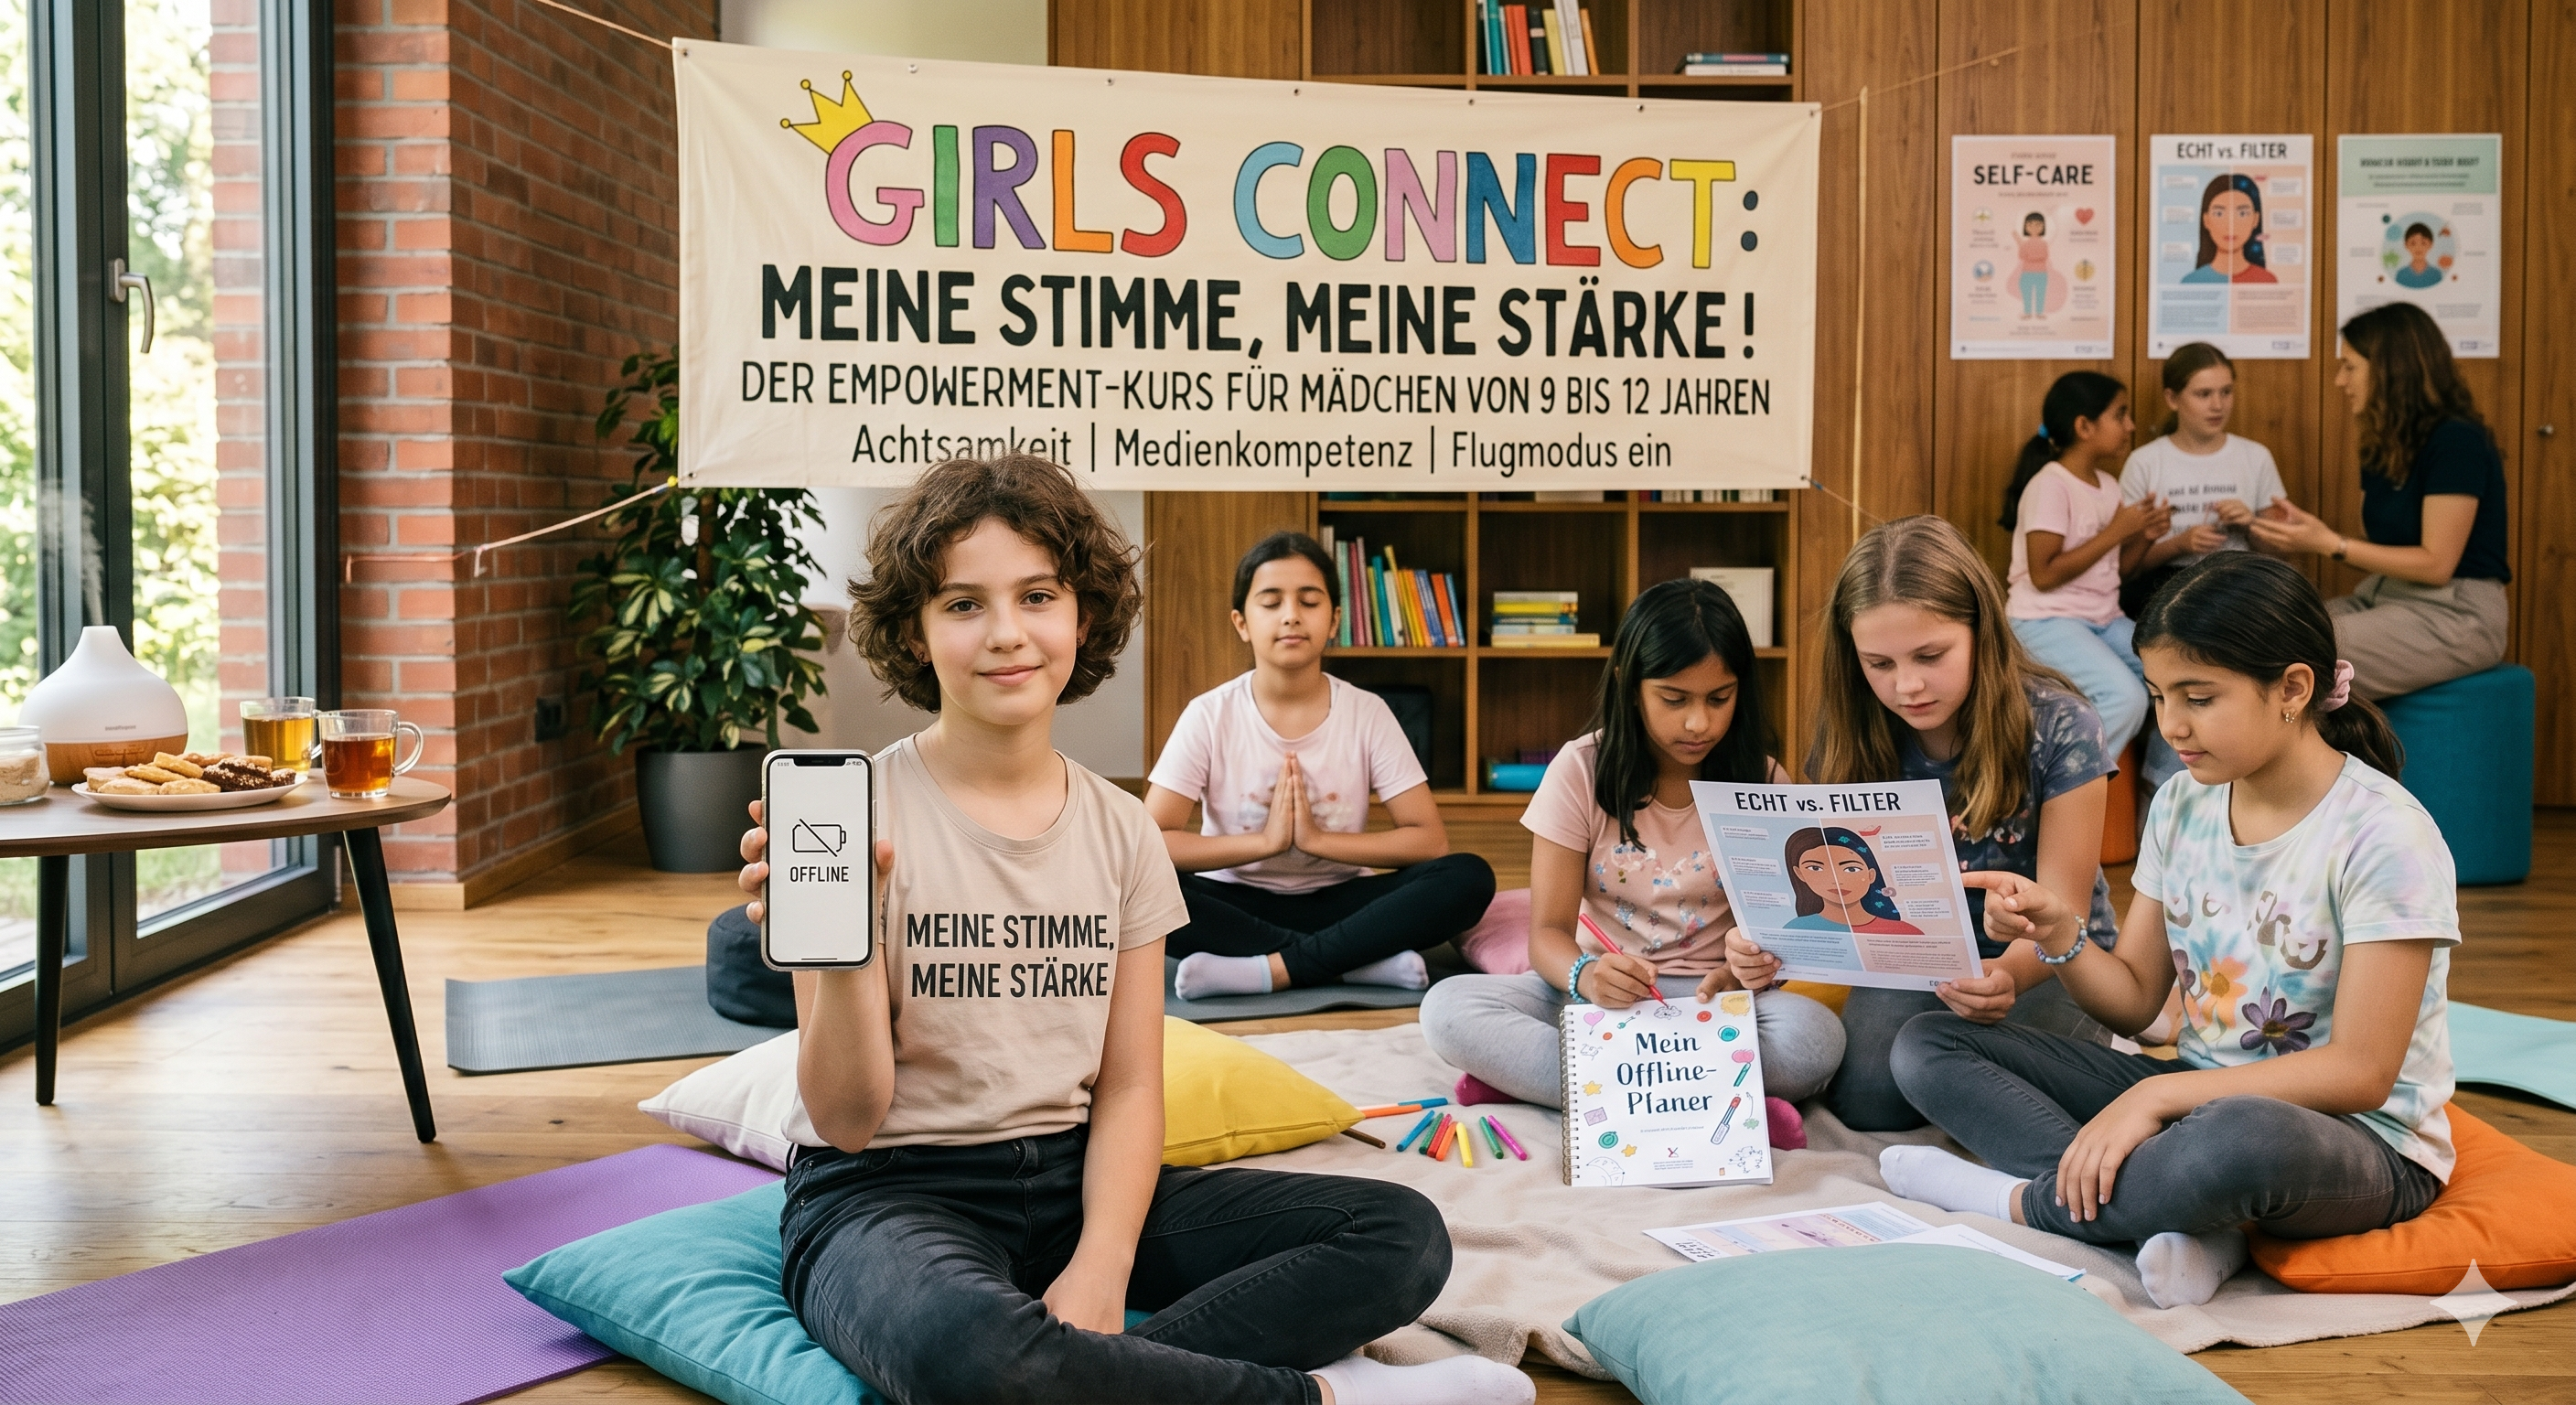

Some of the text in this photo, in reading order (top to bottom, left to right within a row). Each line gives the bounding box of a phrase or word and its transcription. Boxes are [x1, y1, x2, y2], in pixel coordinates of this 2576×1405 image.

[2177, 142, 2214, 159] ECHT
[2240, 142, 2288, 159] FILTER
[1973, 164, 2094, 186] SELF-CARE
[825, 120, 1759, 269] GIRLS CONNECT:
[762, 263, 976, 345] MEINE
[1000, 273, 1263, 360] STIMME,
[1286, 281, 1476, 356] MEINE
[742, 360, 1770, 415] DER EMPOWERMENT-KURS FÜR MÄDCHEN VON 9 BIS 12 JAHREN
[852, 423, 1072, 465] Achtsamkeit
[1115, 427, 1412, 478] Medienkompetenz
[1453, 430, 1618, 479] Flugmodus
[1628, 432, 1671, 467] ein
[1734, 791, 1902, 813] ECHT vs. FILTER
[789, 865, 850, 883] OFFLINE
[907, 913, 1114, 951] MEINE STIMME,
[911, 956, 1109, 998] MEINE STÄRKE
[1636, 1032, 1701, 1056] Mein
[1616, 1061, 1717, 1088] Offline-
[1626, 1091, 1713, 1115] Planer
